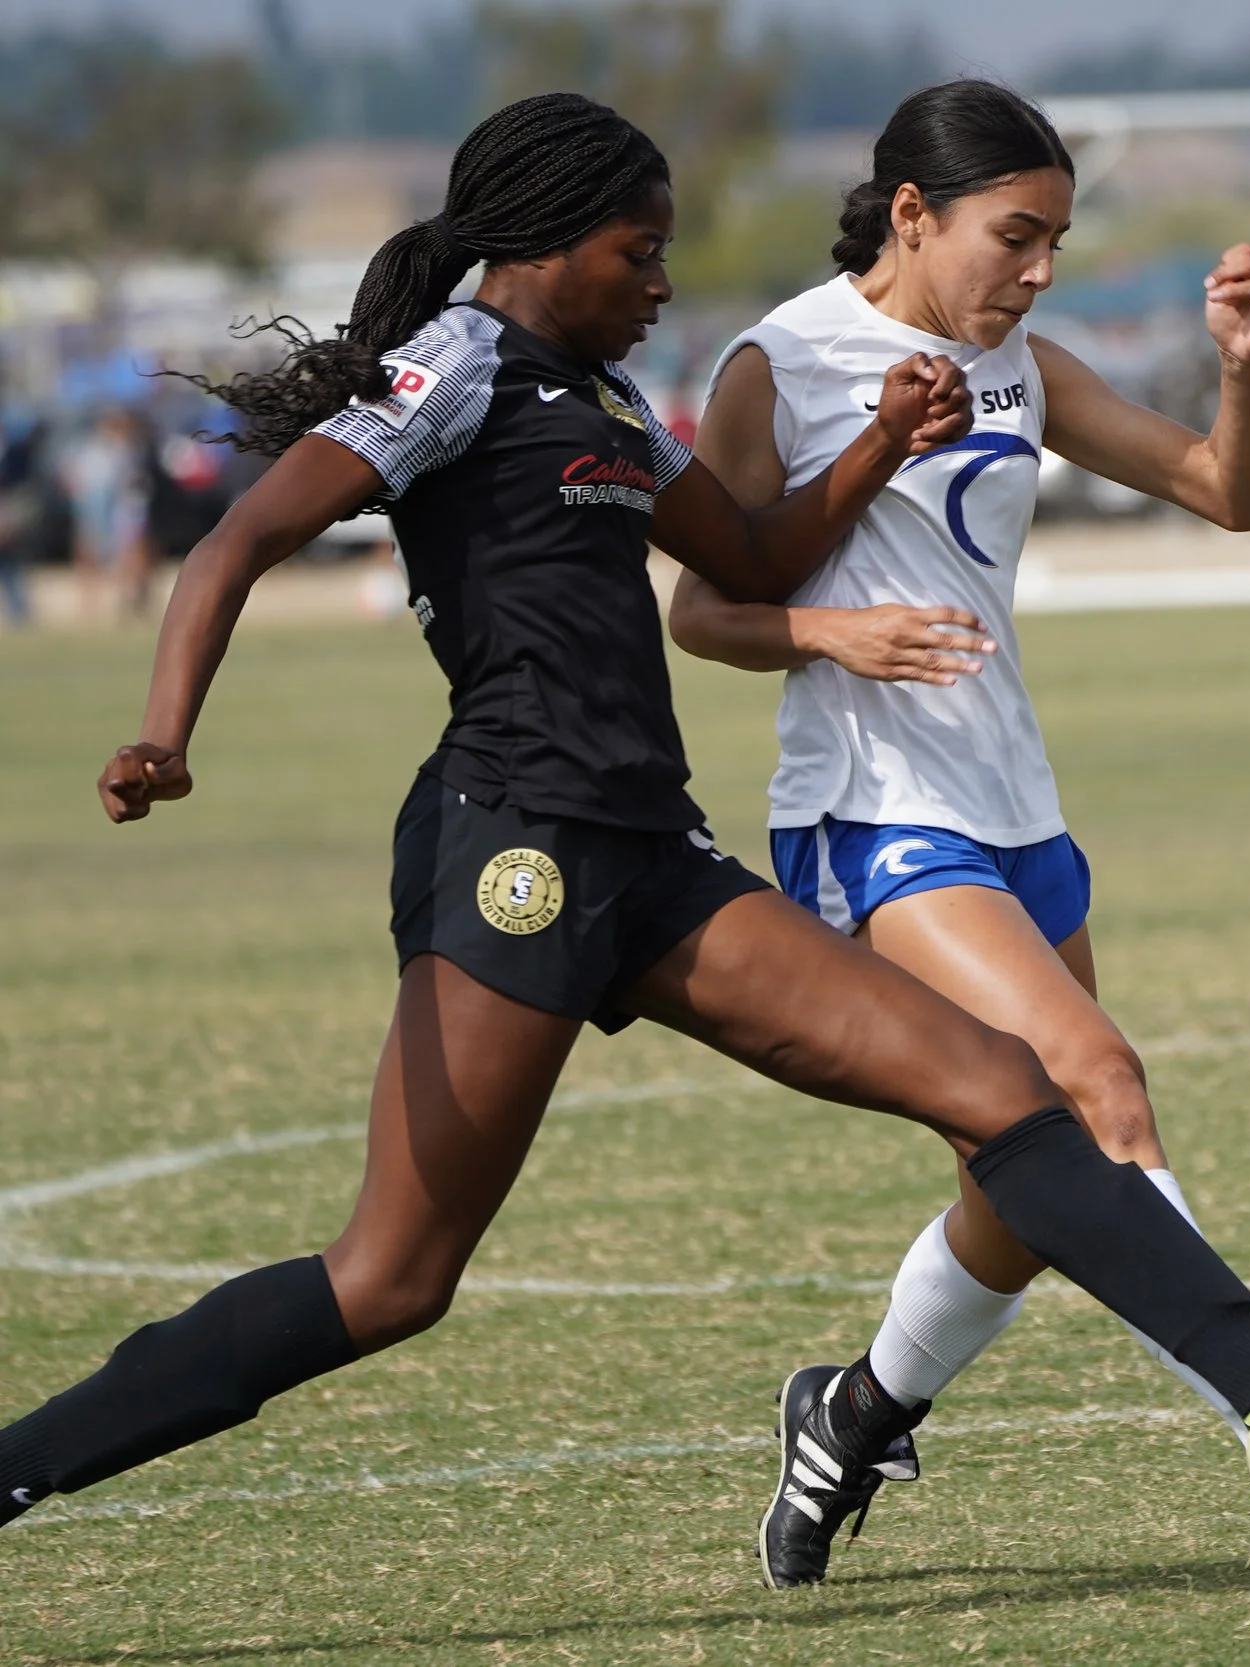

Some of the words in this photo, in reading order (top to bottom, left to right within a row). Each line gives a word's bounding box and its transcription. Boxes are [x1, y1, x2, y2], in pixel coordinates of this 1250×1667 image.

[493, 851, 531, 869] SOCAL
[534, 856, 559, 883] ELITE
[480, 890, 523, 932] FOOTBALL
[527, 907, 554, 931] CLUB
